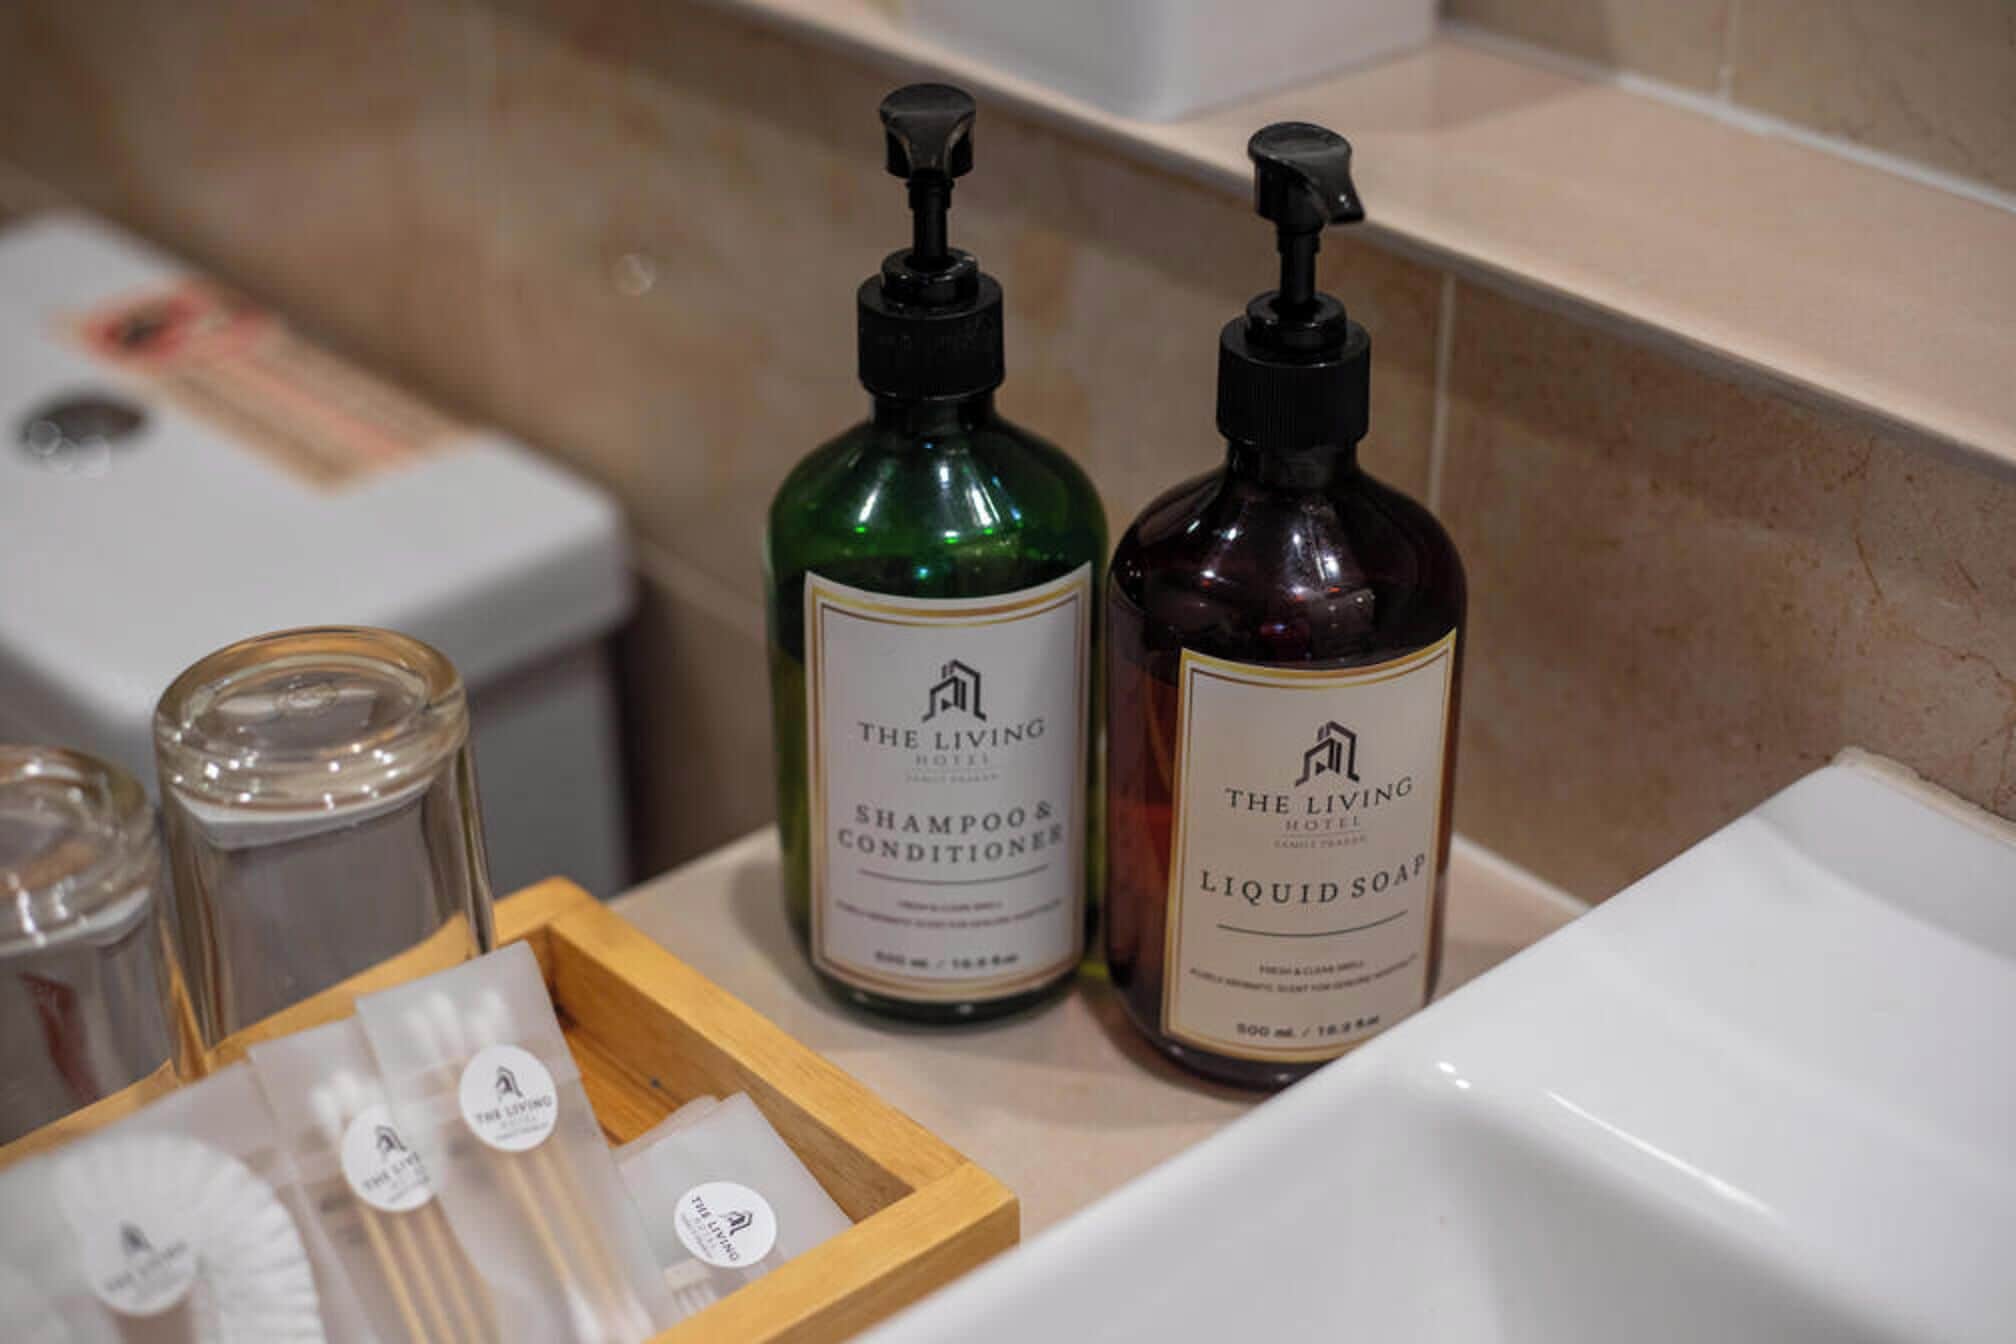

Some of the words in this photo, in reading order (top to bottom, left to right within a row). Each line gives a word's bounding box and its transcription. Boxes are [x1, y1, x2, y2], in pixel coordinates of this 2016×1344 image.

[858, 721, 919, 749] THE
[935, 718, 1046, 750] LIVING
[915, 754, 990, 767] HOTEL
[1225, 787, 1290, 815] THE
[1306, 775, 1413, 815] LIVING
[855, 804, 1026, 836] SHAMPOO
[1035, 800, 1052, 820] &
[1285, 815, 1361, 832] HOTEL
[837, 823, 1063, 865] CONDITIONER
[1200, 870, 1339, 907] LIQUID
[1351, 853, 1425, 899] SOAP
[1236, 1022, 1271, 1038] 500
[692, 1195, 713, 1219] THE
[707, 1220, 740, 1262] LIVING
